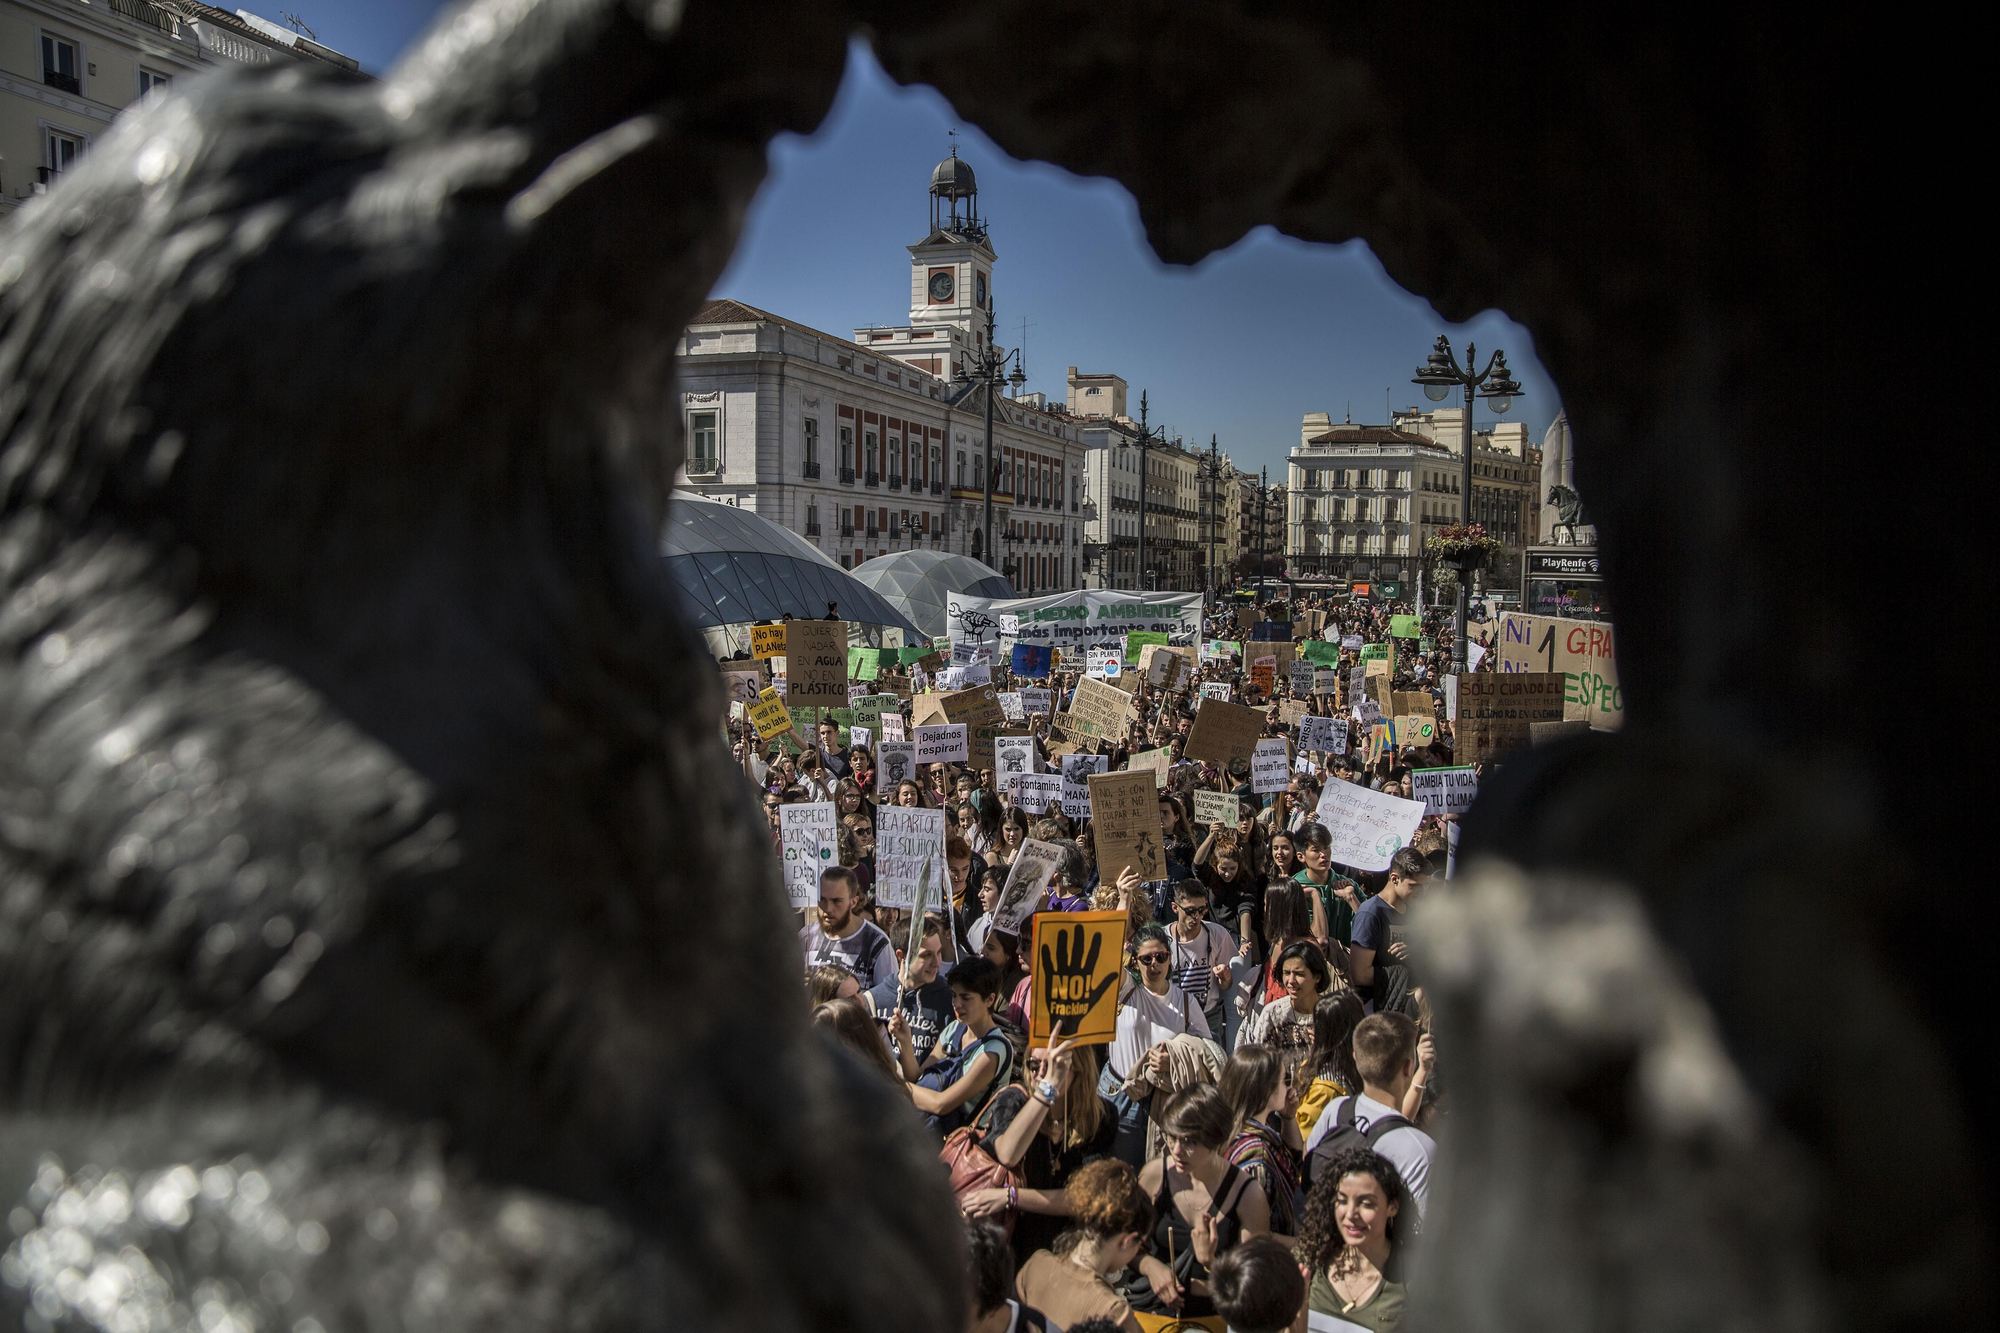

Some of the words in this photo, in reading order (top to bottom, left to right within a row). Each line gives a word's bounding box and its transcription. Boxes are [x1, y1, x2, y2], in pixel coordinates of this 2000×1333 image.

[1542, 558, 1587, 568] PlayRenfe
[1542, 594, 1573, 606] renfe
[1033, 606, 1089, 622] MEDIO
[1096, 603, 1182, 619] AMBIENTE
[753, 629, 768, 643] ¡No
[769, 628, 783, 640] hay
[801, 626, 839, 637] QUIERO
[1018, 624, 1050, 638] más
[1054, 624, 1145, 641] importante
[1181, 620, 1197, 634] los
[803, 640, 836, 651] NADAR
[1506, 618, 1532, 645] Ni
[1566, 627, 1613, 659] GRA
[798, 656, 810, 666] EN
[814, 656, 843, 666] AGUA
[803, 670, 818, 681] NO
[823, 670, 836, 681] EN
[1546, 683, 1562, 694] EL
[1565, 672, 1624, 713] ESPEC
[764, 690, 778, 702] wait
[755, 705, 769, 721] until
[769, 704, 779, 715] it's
[855, 712, 876, 725] ¡Gas
[1462, 709, 1474, 719] EL
[758, 724, 772, 734] too
[772, 715, 789, 727] late.
[1055, 713, 1067, 727] POR
[1066, 716, 1074, 729] EL
[1074, 718, 1102, 738] PLANETA
[919, 730, 961, 744] ¡Dejadnos
[1299, 717, 1313, 750] CRISIS
[918, 742, 962, 756] respirar!
[975, 741, 995, 749] CLIMA
[1269, 747, 1286, 757] violada,
[1260, 762, 1274, 771] madre
[1274, 761, 1287, 771] Tierra
[1010, 777, 1018, 789] Si
[1020, 780, 1063, 794] contamina,
[1263, 776, 1274, 788] hijos
[1415, 774, 1443, 789] CAMBIA
[1444, 774, 1454, 787] TU
[1456, 773, 1476, 788] VIDA,
[1064, 788, 1090, 800] MAÑA
[1100, 787, 1113, 798] NO,
[1011, 794, 1019, 805] te
[1021, 794, 1040, 806] roba
[1100, 800, 1112, 809] TAL
[1132, 796, 1144, 806] NO
[1328, 783, 1376, 812] Pretender
[1383, 808, 1398, 820] que
[1402, 810, 1417, 821] el
[1431, 794, 1443, 807] TU
[1446, 793, 1474, 807] CLIMA
[1064, 803, 1081, 815] SERÁ
[1102, 810, 1127, 820] CULPAR
[1132, 809, 1142, 817] AL
[788, 809, 829, 824] RESPECT
[891, 813, 898, 831] A
[902, 813, 925, 833] PART
[1323, 802, 1354, 818] cambio
[1357, 812, 1397, 832] climático
[1330, 818, 1340, 828] es
[1103, 822, 1115, 831] SER
[783, 827, 836, 843] EXINCE
[1350, 835, 1371, 849] QUE
[899, 836, 942, 857] SOLUTION
[1332, 845, 1383, 865] SAPAREZCA
[900, 882, 940, 905] POLION
[1051, 974, 1091, 1000] NO!
[1050, 1001, 1089, 1016] Fracking
